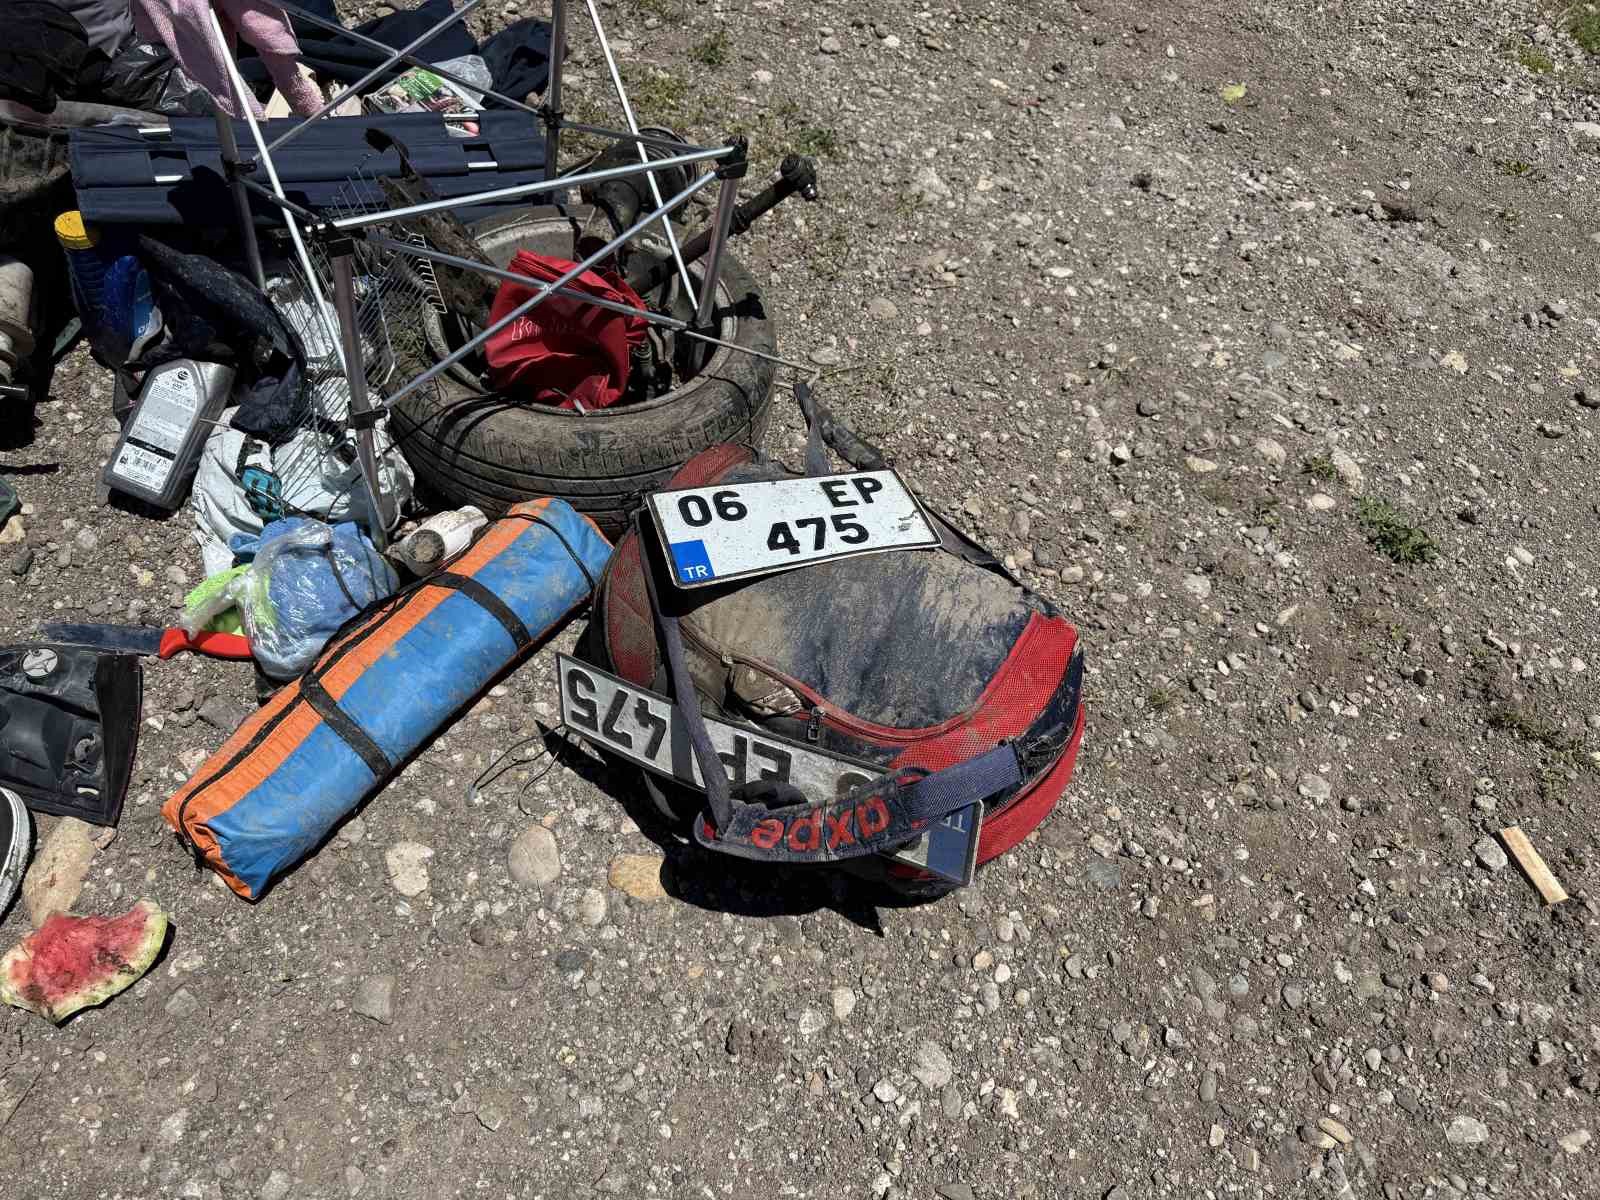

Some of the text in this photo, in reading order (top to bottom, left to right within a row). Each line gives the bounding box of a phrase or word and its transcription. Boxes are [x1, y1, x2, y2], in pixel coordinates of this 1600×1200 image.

[677, 477, 883, 528] 06 EP
[767, 513, 869, 555] 475
[683, 564, 709, 579] TR
[567, 668, 667, 760] 475
